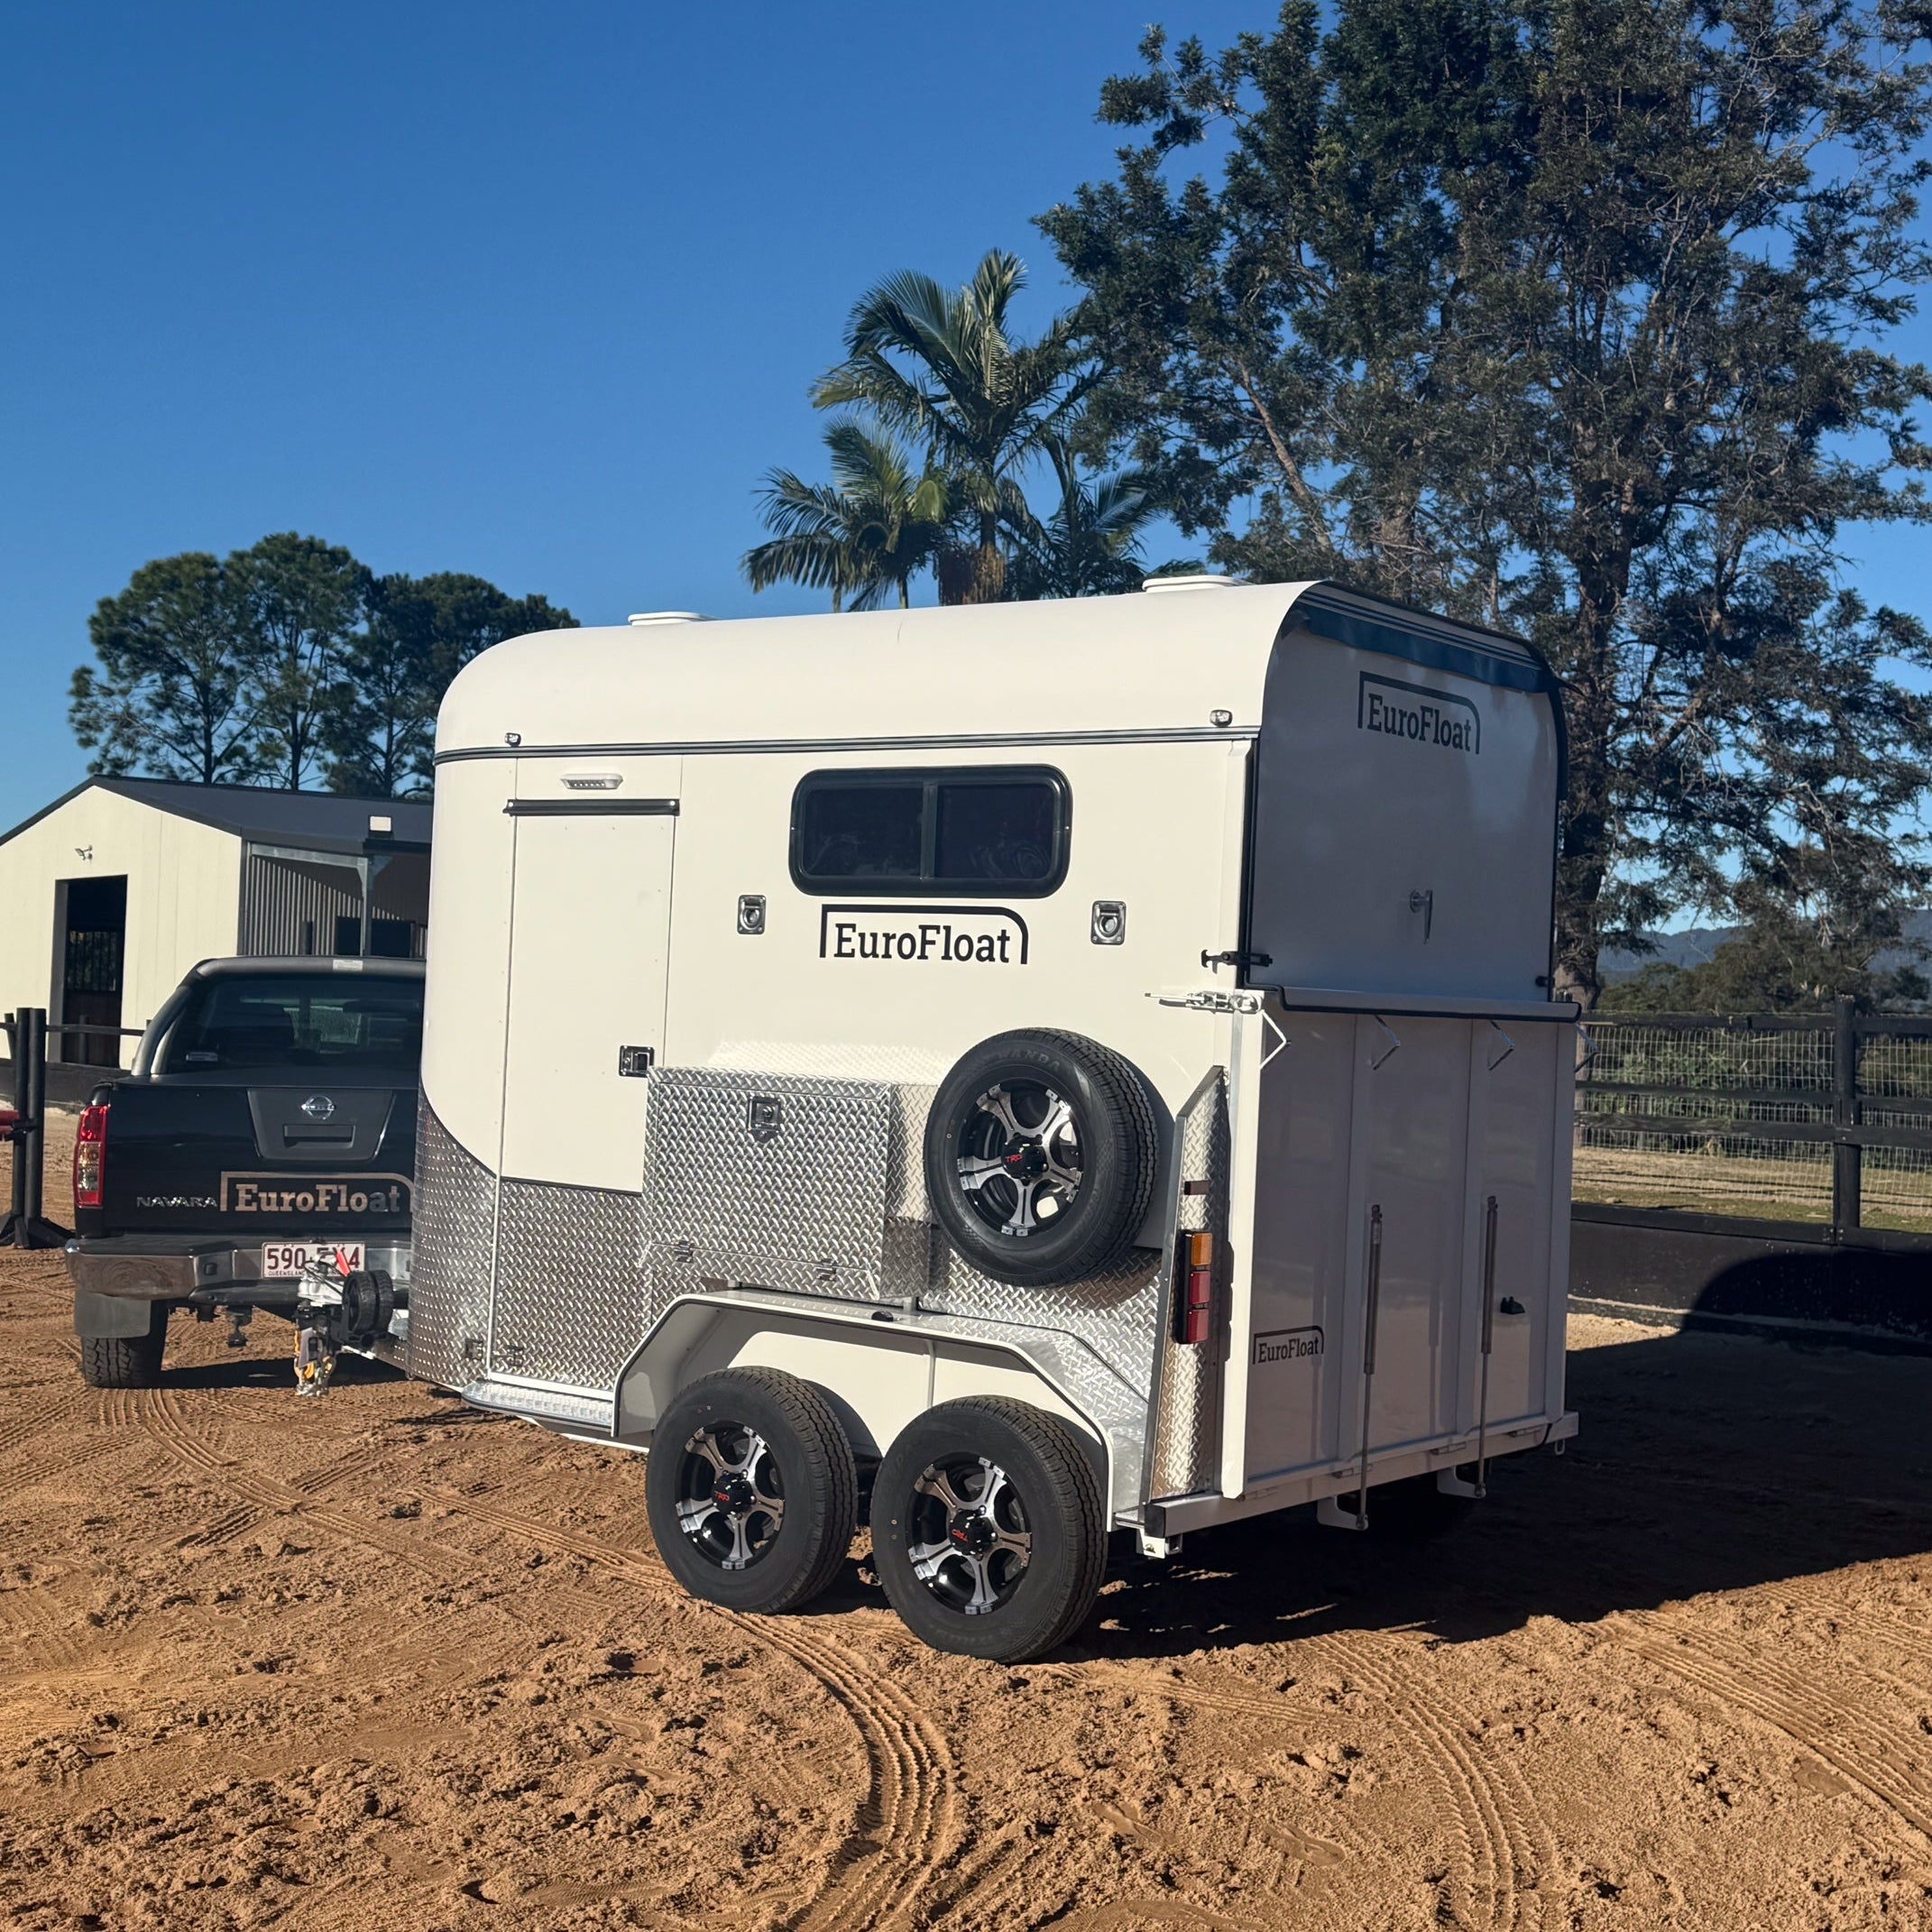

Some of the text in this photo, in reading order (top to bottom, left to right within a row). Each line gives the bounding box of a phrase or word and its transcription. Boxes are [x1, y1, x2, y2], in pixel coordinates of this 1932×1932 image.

[1367, 693, 1471, 751] EuroFloat
[833, 923, 1010, 963] EuroFloat
[136, 1196, 218, 1208] NAVARA
[235, 1183, 400, 1212] EuroFloat
[267, 1247, 306, 1270] 590
[1258, 1336, 1320, 1364] EuroFloat
